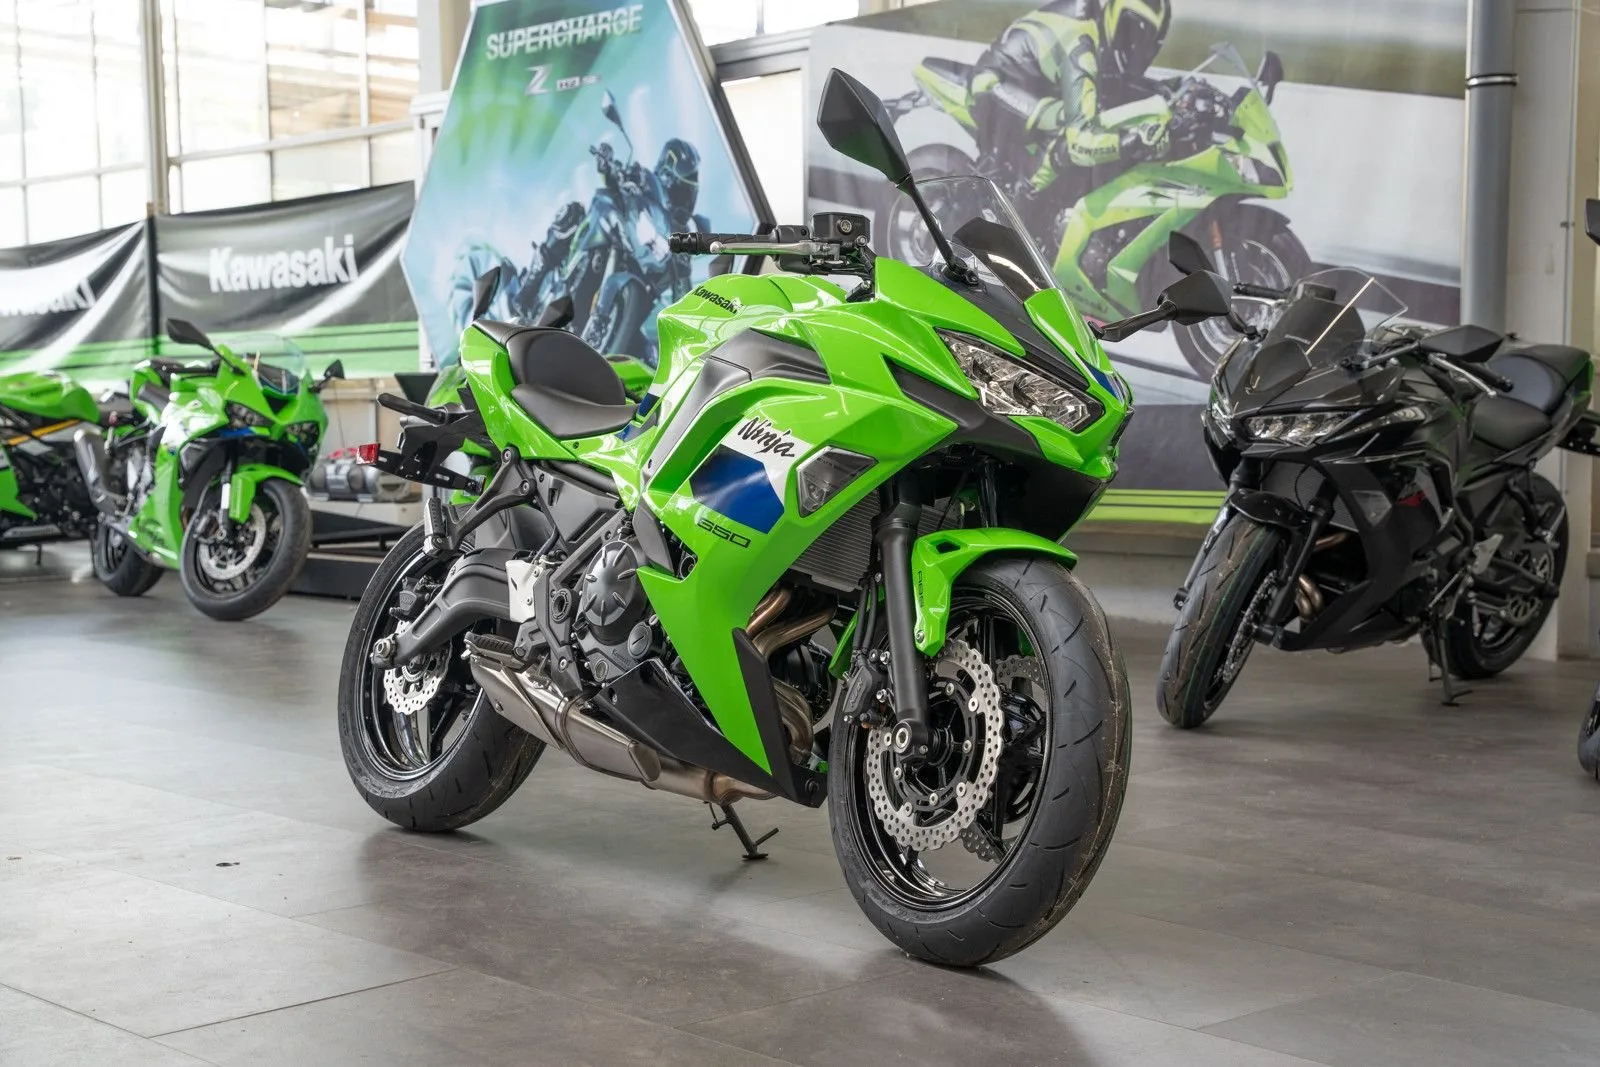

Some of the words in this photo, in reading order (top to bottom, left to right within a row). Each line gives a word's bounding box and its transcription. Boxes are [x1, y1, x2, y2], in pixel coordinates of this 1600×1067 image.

[486, 4, 644, 61] SUPERCHARGE
[525, 63, 553, 96] Z
[209, 234, 358, 293] Kawasaki
[737, 416, 796, 458] Ninja
[697, 517, 752, 549] 650
